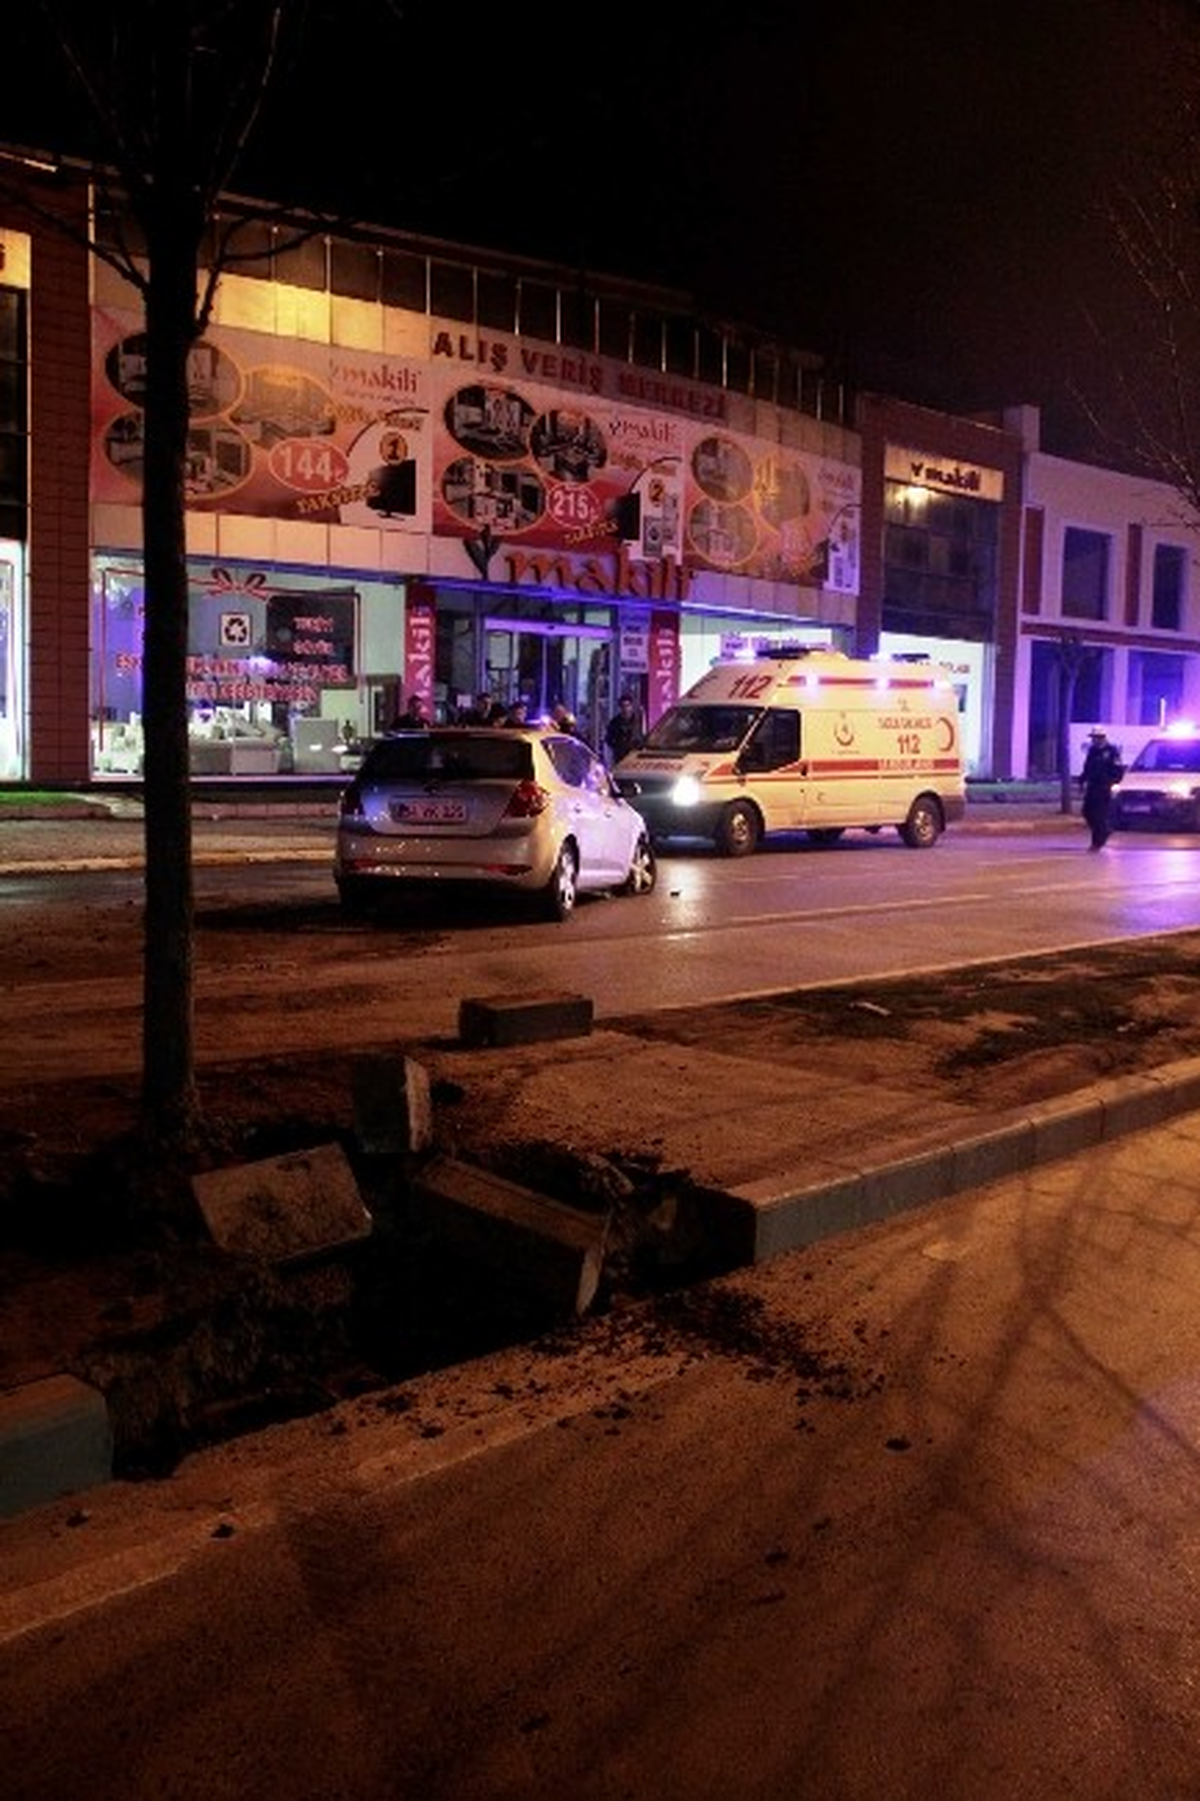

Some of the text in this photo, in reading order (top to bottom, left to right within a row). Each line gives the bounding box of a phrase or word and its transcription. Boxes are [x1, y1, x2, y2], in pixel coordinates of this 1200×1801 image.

[432, 331, 508, 373] ALIŞ
[519, 347, 601, 393] VERİŞ
[280, 446, 333, 483] 144
[553, 490, 589, 519] 215
[729, 674, 774, 699] 112
[897, 733, 921, 755] 112
